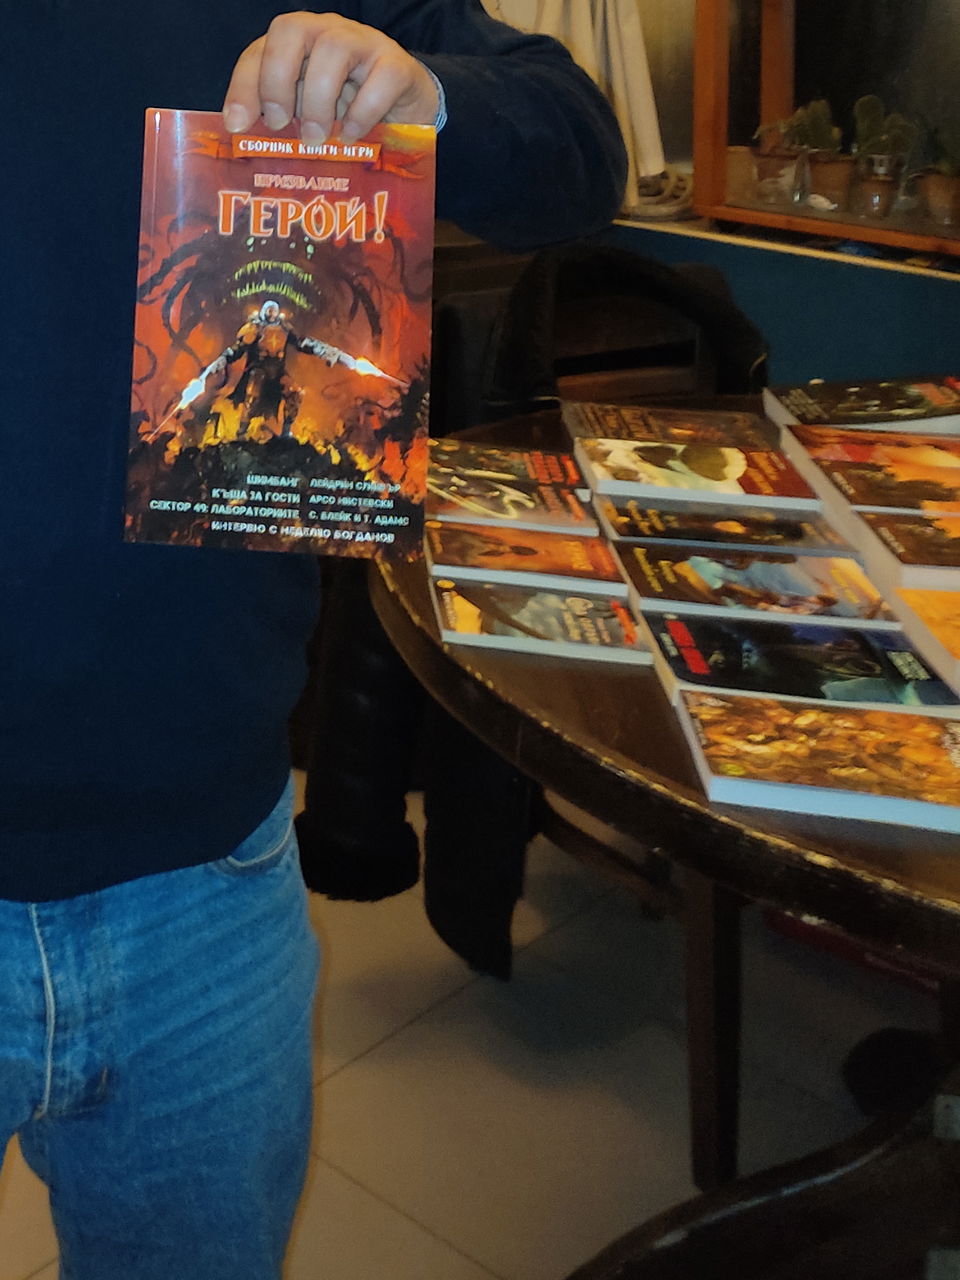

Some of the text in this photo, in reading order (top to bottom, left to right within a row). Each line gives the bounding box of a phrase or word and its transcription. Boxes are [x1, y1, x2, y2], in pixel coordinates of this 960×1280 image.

[239, 139, 293, 154] СБОРНИК
[254, 173, 350, 192] ПРИЗВАНИЕ
[218, 190, 388, 244] ГЕРОЙ!
[249, 490, 263, 501] ЗА
[265, 491, 300, 503] ГОСТИ
[149, 499, 192, 512] СЕКТОР
[210, 504, 300, 519] ЛАБОРАТОРИИТЕ
[374, 514, 410, 526] АДАМС
[211, 520, 266, 534] ИНТЕРВЮ
[268, 524, 278, 535] С
[333, 528, 395, 544] БОГДАНОВ
